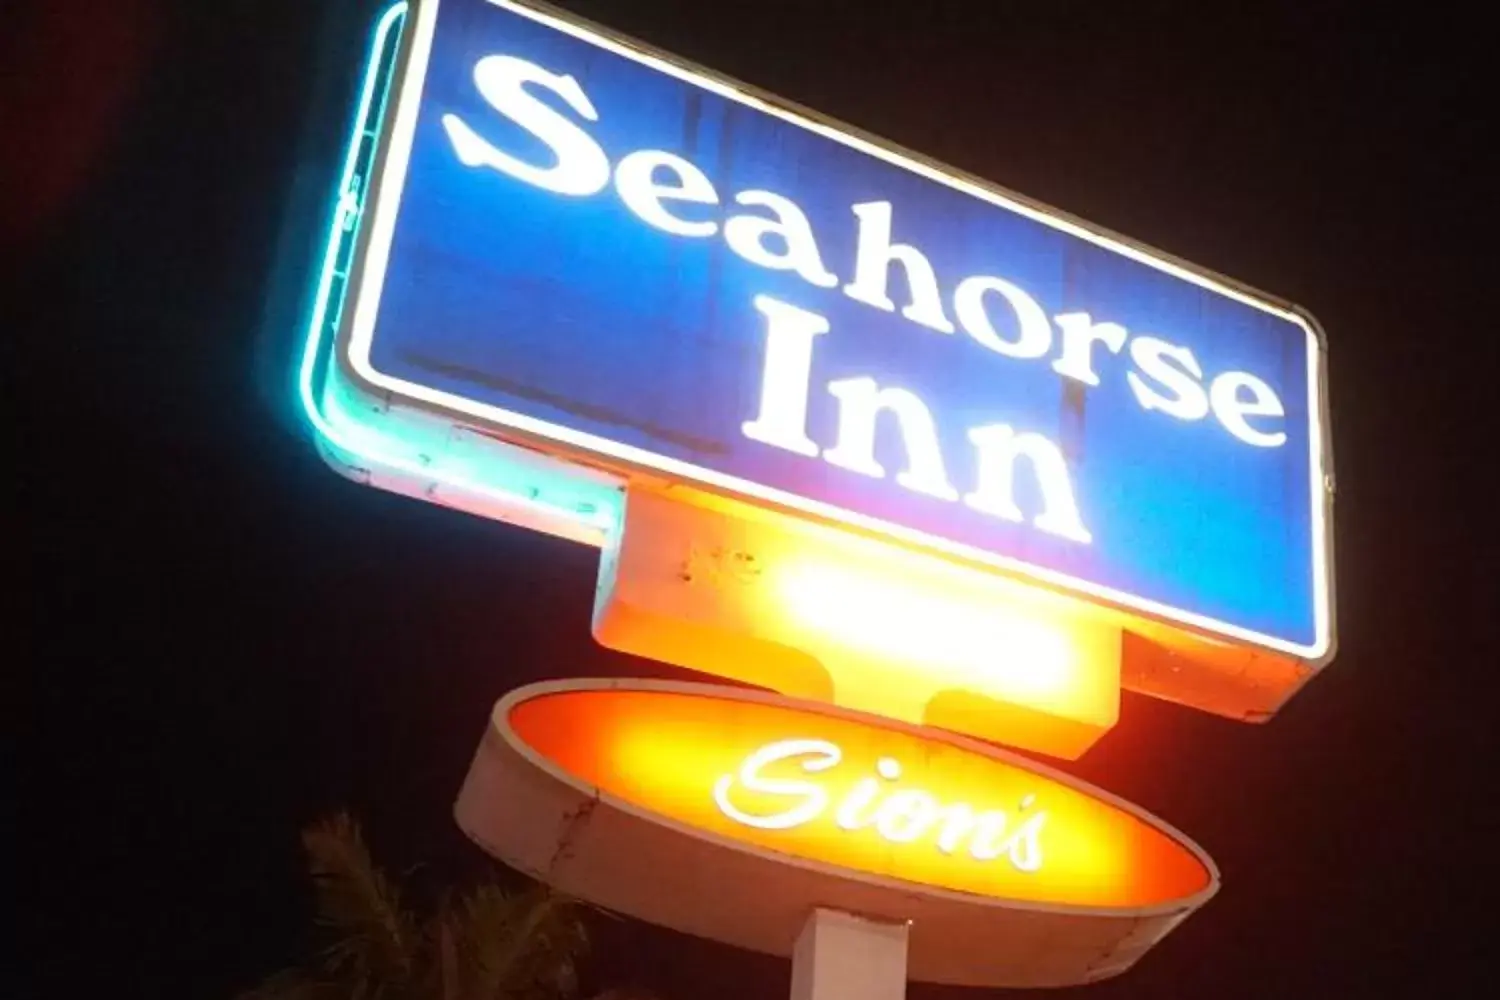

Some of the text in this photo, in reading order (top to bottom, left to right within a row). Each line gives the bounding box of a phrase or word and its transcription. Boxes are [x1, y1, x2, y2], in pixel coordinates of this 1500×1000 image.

[443, 54, 1287, 447] Seahorse
[741, 293, 1092, 544] Inn
[713, 738, 1048, 872] Sion's
